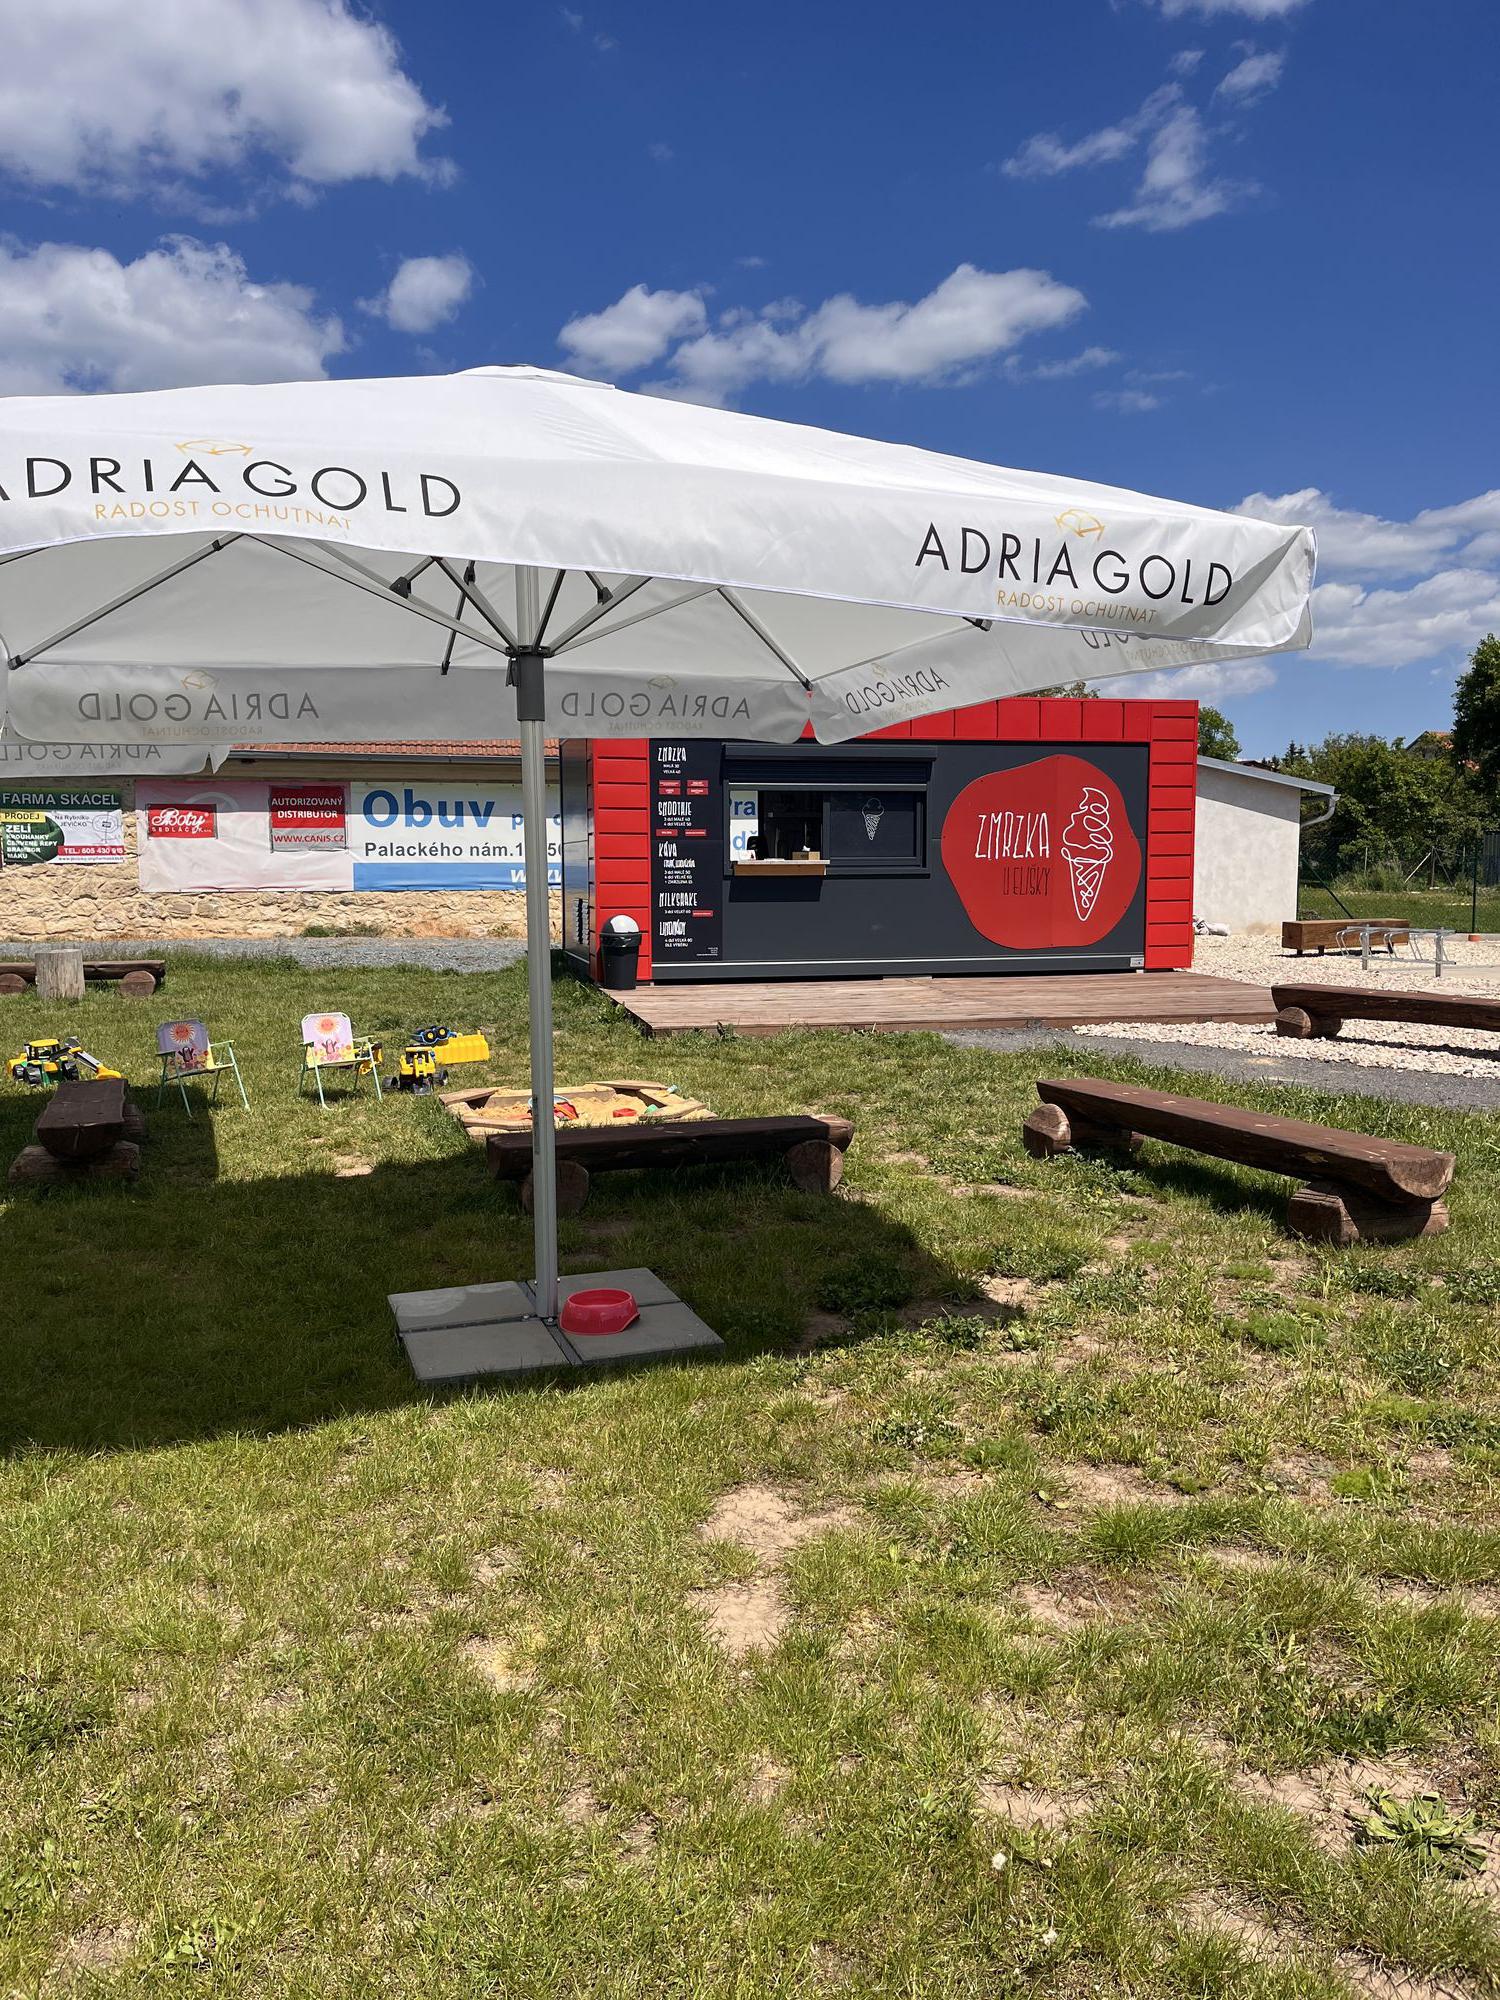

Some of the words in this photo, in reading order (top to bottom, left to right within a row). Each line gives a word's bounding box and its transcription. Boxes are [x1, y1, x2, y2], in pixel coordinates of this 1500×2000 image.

[0, 457, 220, 501] DRIA
[243, 460, 461, 517] GOLD
[95, 501, 200, 520] RADOST
[211, 501, 352, 530] OCHUTNAT
[915, 522, 1079, 589] ADRIA
[1093, 550, 1233, 606] GOLD
[996, 589, 1065, 613] RADOST
[1070, 599, 1157, 624] OCHUTNAT
[2, 793, 56, 805] FARMA
[60, 791, 119, 805] SKÁCEL
[271, 796, 343, 806] AUTORIZOVANÝ
[362, 789, 495, 828] Obuv
[658, 801, 692, 816] SMOOTHIE
[277, 810, 338, 818] DISTRIBUTOR
[975, 811, 1050, 860] ZMRZKA
[365, 842, 463, 857] Palackého
[658, 841, 677, 857] KÁVA
[1003, 866, 1010, 896] U
[1013, 864, 1051, 896] ELIŠKY
[659, 892, 698, 907] MILKSHAKE
